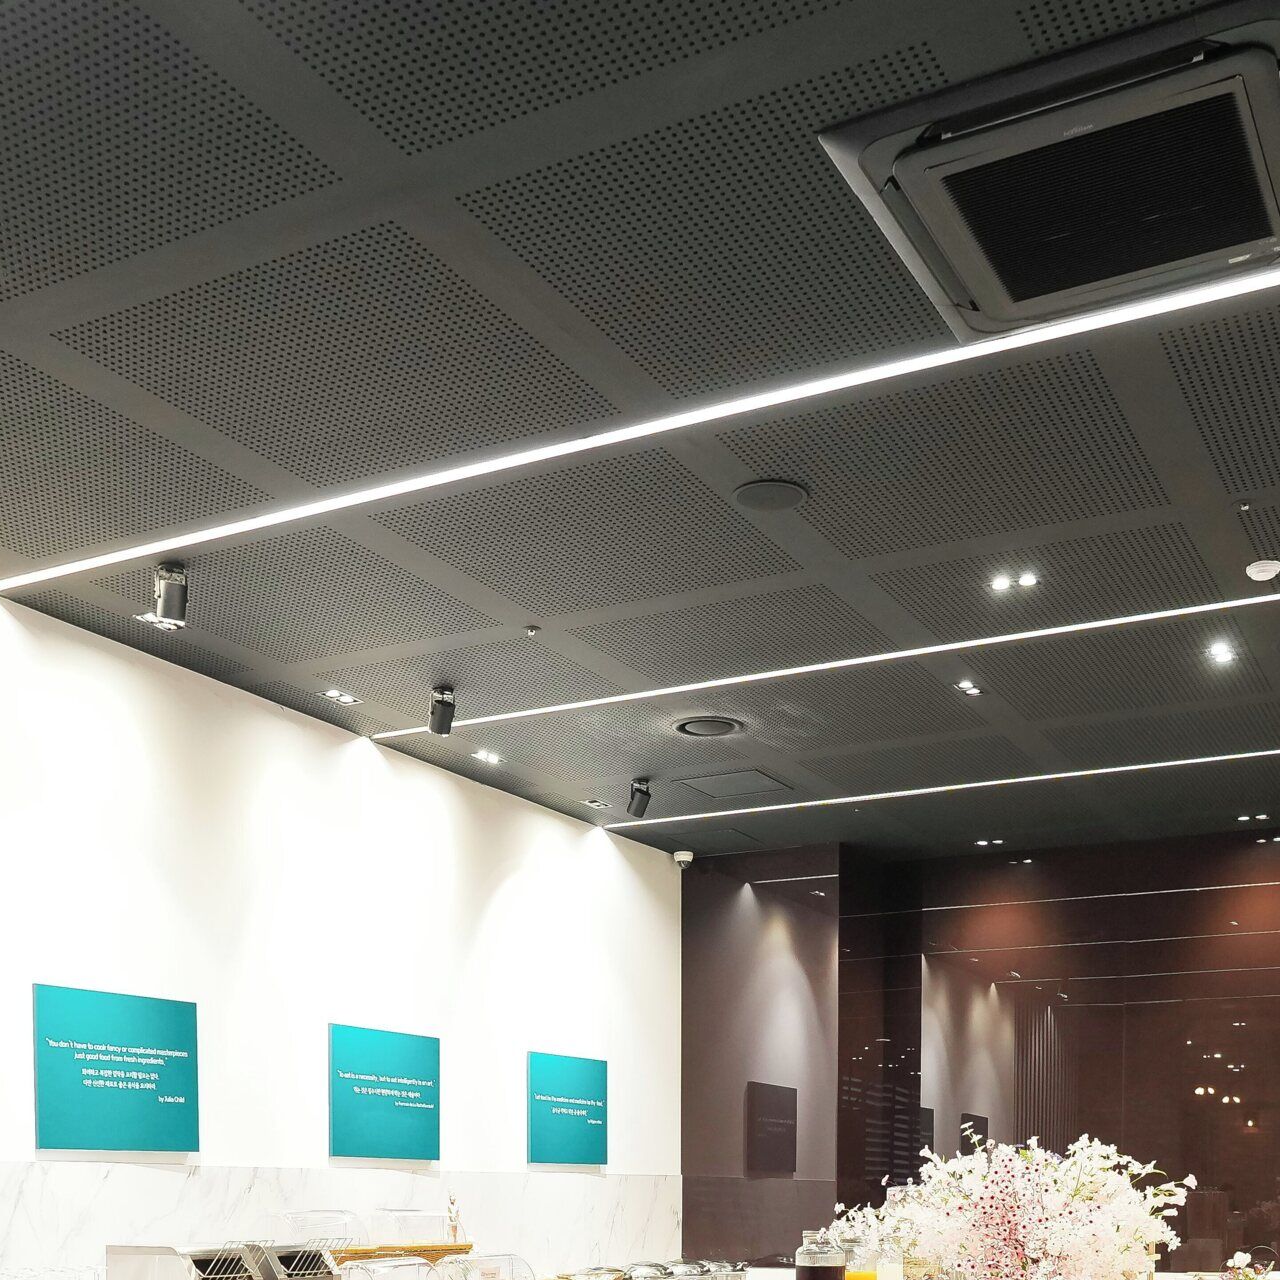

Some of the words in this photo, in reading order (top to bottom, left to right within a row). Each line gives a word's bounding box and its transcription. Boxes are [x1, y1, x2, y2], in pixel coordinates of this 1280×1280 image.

[74, 1041, 87, 1049] have
[87, 1042, 94, 1050] to
[94, 1043, 106, 1051] cook
[107, 1044, 121, 1053] fancy
[128, 1046, 156, 1055] complicated
[86, 1053, 98, 1061] good
[99, 1053, 110, 1061] food
[111, 1054, 123, 1062] from
[123, 1055, 137, 1063] fresh
